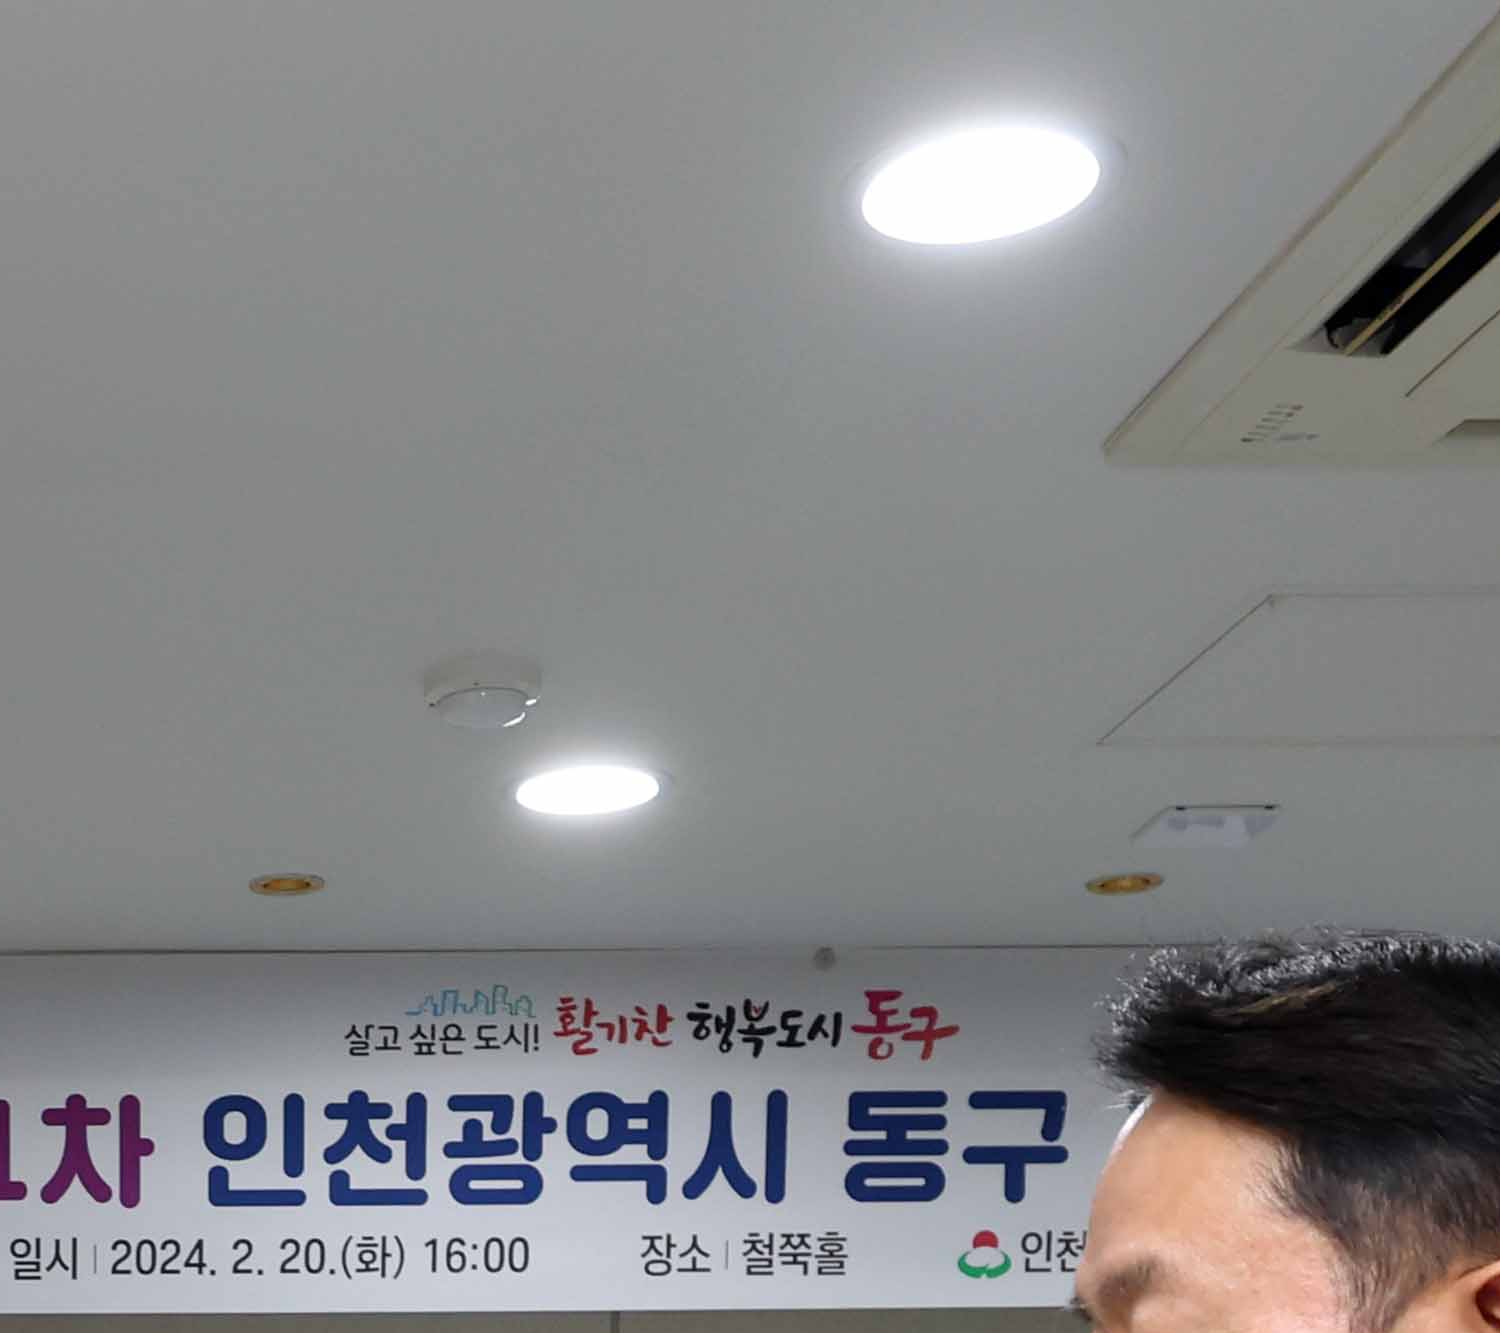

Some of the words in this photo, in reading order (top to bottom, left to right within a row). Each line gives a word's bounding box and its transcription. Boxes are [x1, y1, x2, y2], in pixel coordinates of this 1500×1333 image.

[346, 1023, 402, 1056] 살고
[410, 1023, 466, 1056] 싶은
[474, 1020, 540, 1054] 도시!
[554, 997, 674, 1056] 활기찬
[687, 998, 843, 1059] 행복도시
[852, 990, 961, 1061] 동구
[203, 1090, 789, 1208] 인천광역시
[844, 1091, 1069, 1204] 동구
[10, 1238, 79, 1281] 일시
[112, 1239, 217, 1276] 2024.
[232, 1239, 264, 1276] 2.
[281, 1236, 405, 1280] 20.(화)
[426, 1238, 530, 1275] 16:00
[641, 1234, 712, 1277] 장소
[743, 1233, 849, 1276] 철쭉홀
